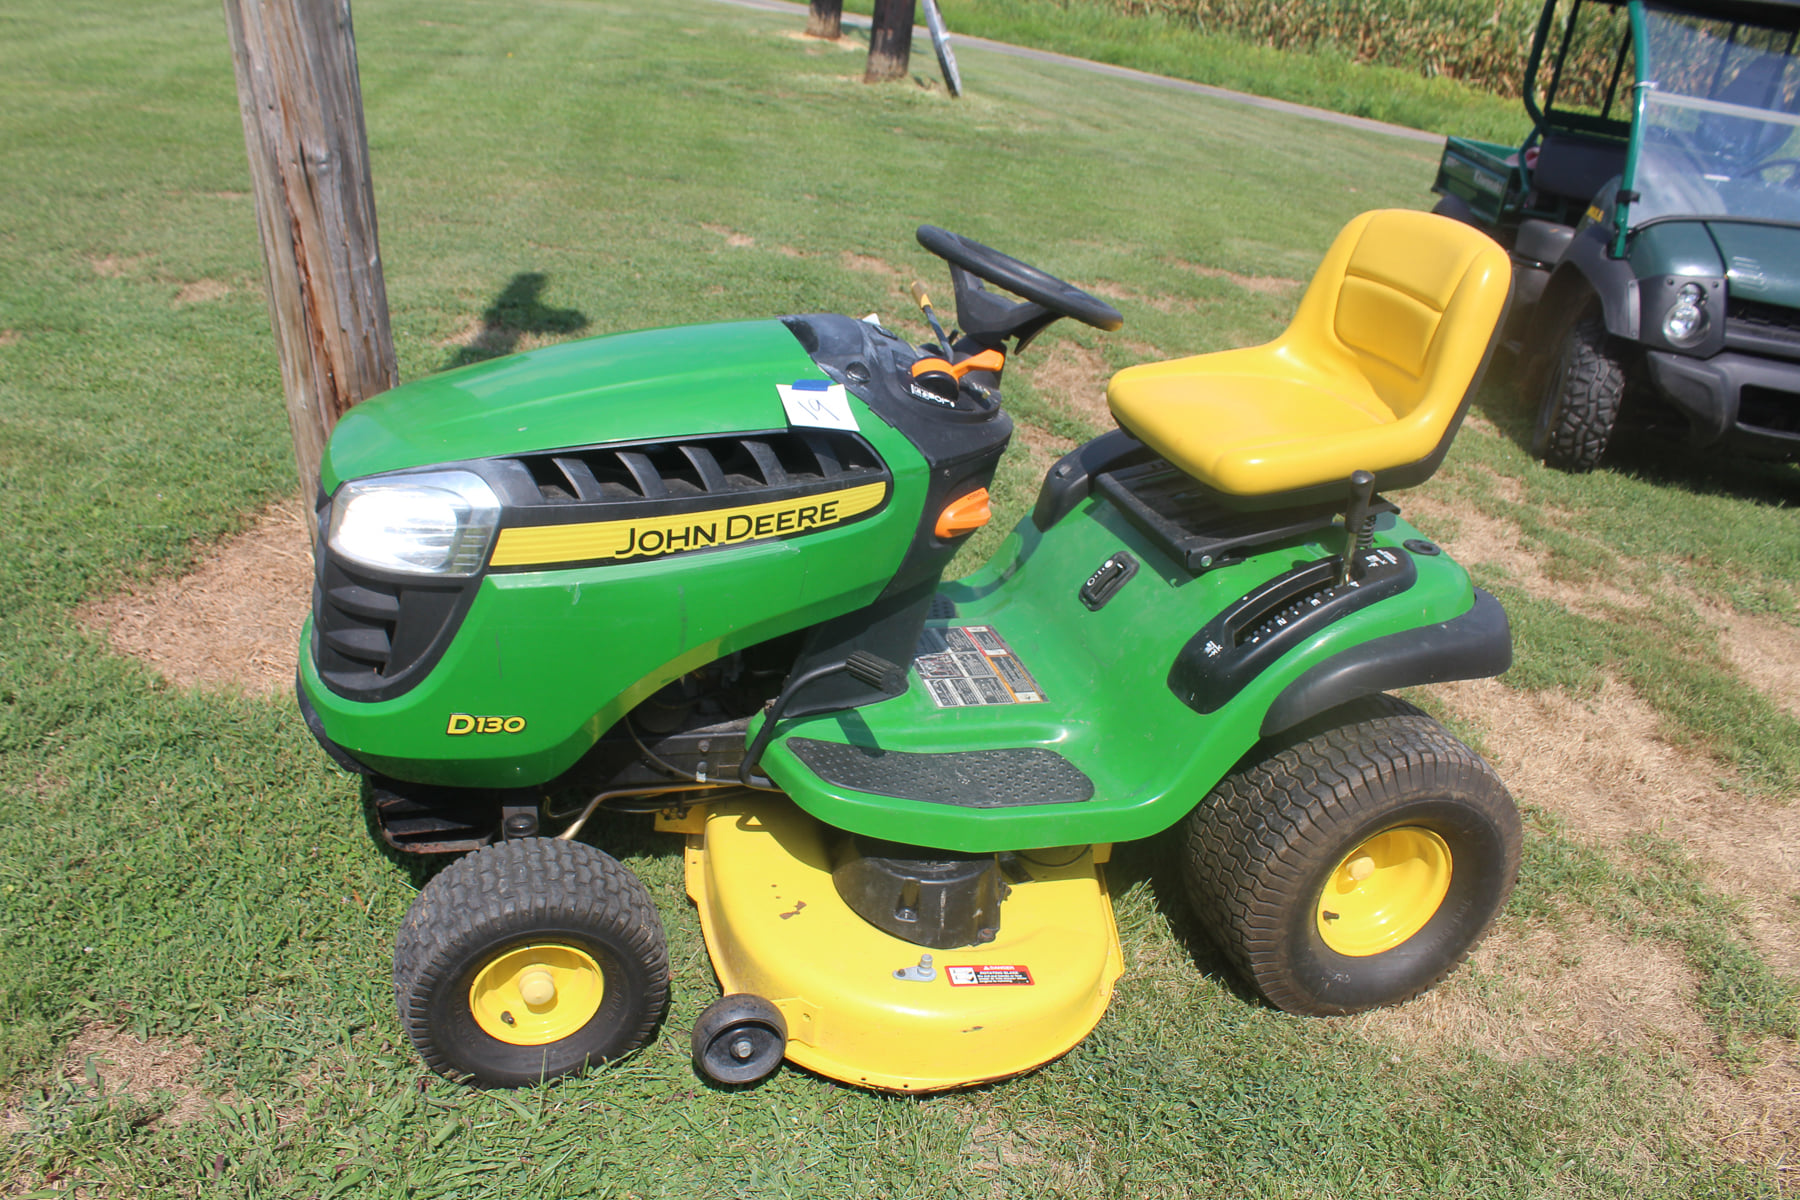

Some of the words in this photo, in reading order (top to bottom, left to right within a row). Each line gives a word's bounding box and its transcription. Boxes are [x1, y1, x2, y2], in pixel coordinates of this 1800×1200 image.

[797, 399, 840, 422] 19
[615, 523, 717, 555] JOHN
[726, 500, 840, 540] DEERE
[446, 713, 527, 735] D130
